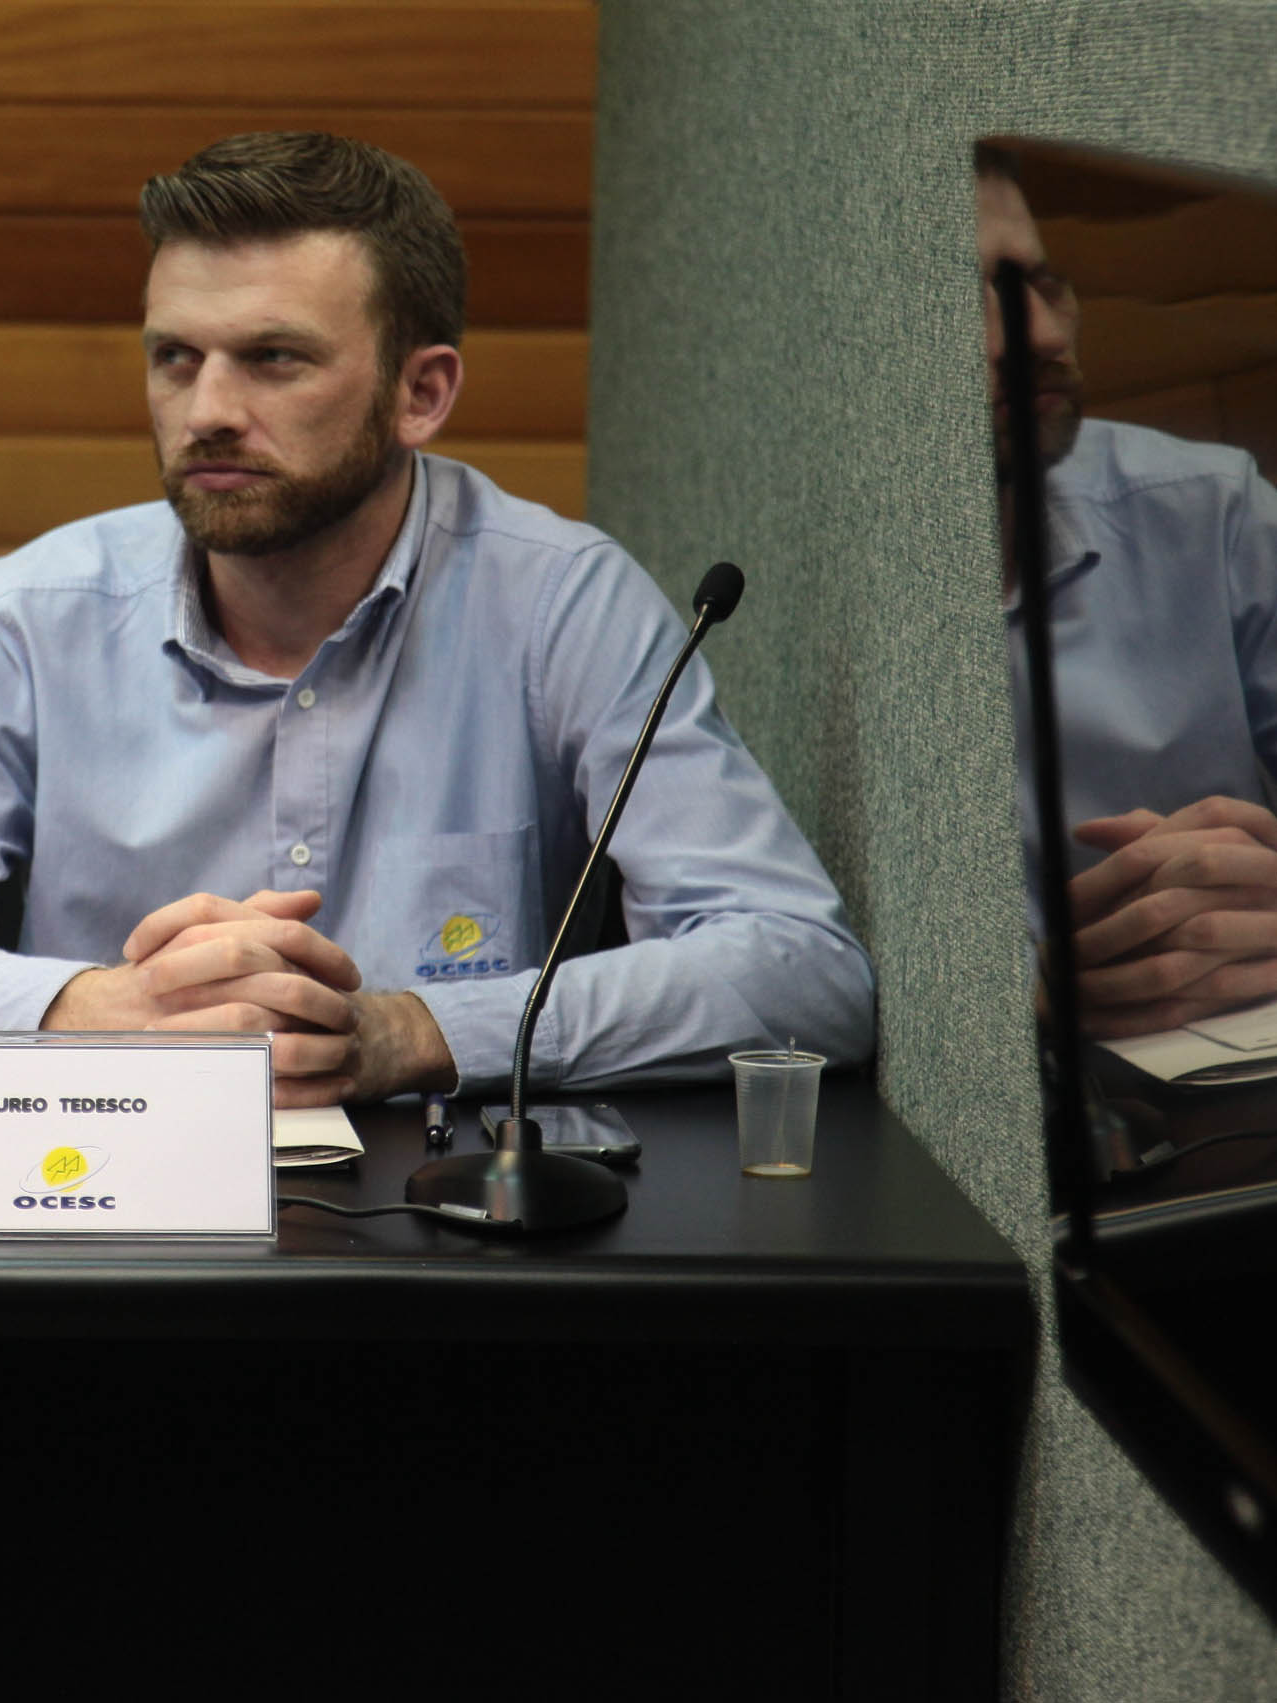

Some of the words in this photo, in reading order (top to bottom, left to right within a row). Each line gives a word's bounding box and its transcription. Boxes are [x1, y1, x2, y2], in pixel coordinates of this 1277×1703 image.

[416, 958, 509, 977] OCESC
[59, 1097, 148, 1114] TEDESCO
[13, 1196, 116, 1210] OCESC
